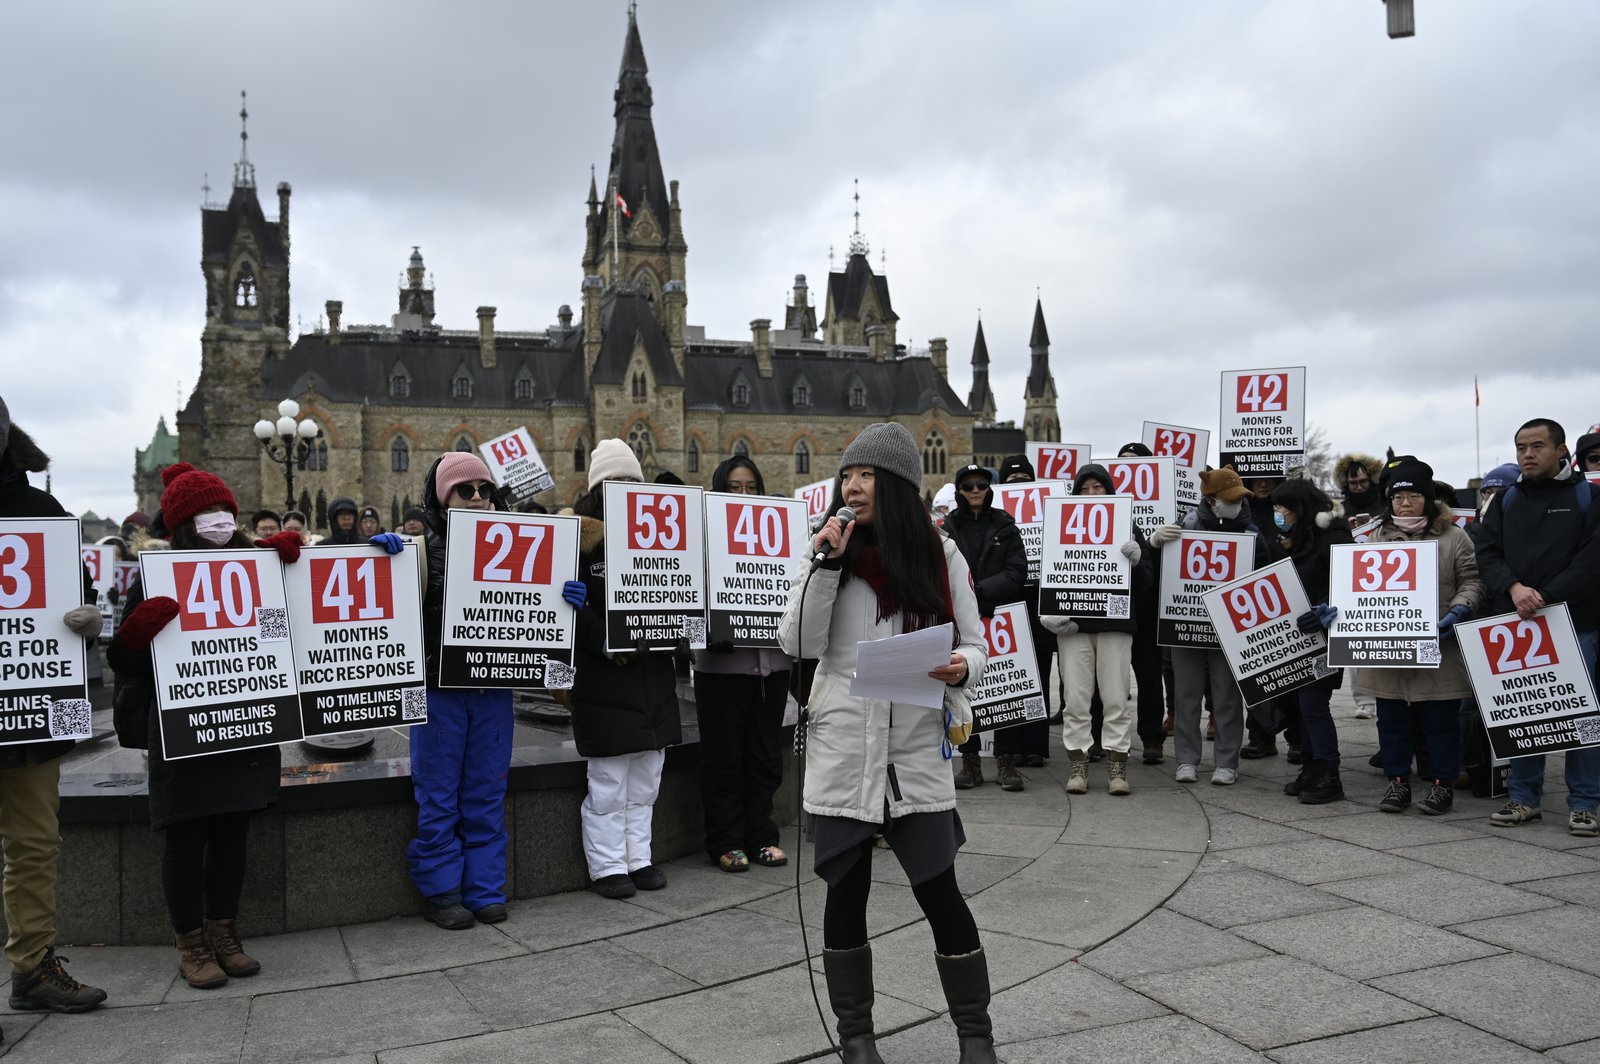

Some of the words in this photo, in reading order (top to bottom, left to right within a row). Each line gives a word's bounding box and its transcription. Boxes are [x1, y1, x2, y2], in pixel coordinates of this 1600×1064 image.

[1242, 374, 1282, 411] 42
[1241, 415, 1282, 426] MONTHS
[1231, 427, 1271, 437] WAITING
[1273, 426, 1293, 436] FOR
[495, 436, 522, 465] 19
[1158, 430, 1191, 466] 32
[1225, 439, 1246, 448] IRCC
[1247, 437, 1298, 447] RESPONSE
[505, 458, 529, 472] MONTHS
[1042, 449, 1072, 479] 72
[1234, 455, 1246, 463] NO
[1246, 454, 1283, 462] TIMELINE
[1238, 464, 1249, 472] NO
[1250, 463, 1284, 471] RESULTS
[502, 467, 526, 481] WAITING
[525, 462, 537, 471] FOR
[514, 467, 543, 484] RESPONSE
[520, 479, 540, 491] TIMELINE
[1113, 463, 1154, 500] 20
[1178, 480, 1194, 490] FOR
[805, 487, 824, 514] 70
[1176, 489, 1198, 500] ONSE
[1008, 488, 1043, 524] 71
[634, 494, 680, 549] 53
[1065, 504, 1109, 544] 40
[1146, 516, 1165, 525] FOR
[733, 505, 783, 556] 40
[1020, 526, 1042, 536] ONTH
[482, 523, 545, 582] 27
[1064, 550, 1107, 560] MONTHS
[1187, 540, 1230, 581] 65
[0, 534, 31, 609] 3
[82, 550, 97, 580] 6
[633, 557, 680, 570] MONTHS
[736, 562, 785, 576] MONTHS
[1053, 562, 1095, 572] WAITING
[1097, 562, 1118, 572] FOR
[1359, 549, 1410, 591] 32
[621, 573, 668, 587] WAITING
[671, 574, 692, 587] FOR
[723, 577, 773, 591] WAITING
[777, 579, 791, 591] FO
[1046, 574, 1069, 584] IRCC
[1070, 574, 1124, 585] RESPONSE
[1184, 583, 1216, 593] MONT
[187, 561, 253, 628] 40
[322, 558, 384, 620] 41
[480, 590, 542, 606] MONTHS
[614, 591, 639, 604] IRCC
[641, 590, 698, 603] RESPONSE
[1055, 591, 1068, 600] NO
[717, 592, 743, 605] IRCC
[745, 593, 788, 606] RESPON
[1059, 602, 1071, 611] NO
[1072, 602, 1108, 611] RESULTS
[1172, 594, 1202, 605] WAITI
[1230, 578, 1282, 629] 90
[1357, 596, 1409, 607] MONTHS
[463, 607, 524, 623] WAITING
[528, 610, 557, 624] FOR
[1165, 605, 1189, 616] IRCC
[1344, 609, 1395, 620] WAITING
[1398, 609, 1423, 619] FOR
[0, 617, 35, 635] THS
[626, 615, 639, 626] NO
[729, 615, 744, 626] NO
[745, 616, 781, 627] TIMELI
[1175, 623, 1188, 632] NO
[1188, 624, 1214, 633] TIMEL
[1337, 622, 1363, 632] IRCC
[1365, 621, 1430, 632] RESPONSE
[324, 626, 388, 644] MONTHS
[452, 625, 486, 640] IRCC
[487, 626, 565, 642] RESPONSE
[630, 629, 643, 640] NO
[645, 628, 684, 640] RESULTS
[734, 628, 748, 639] NO
[750, 628, 779, 639] RESU
[1178, 633, 1191, 641] NO
[1191, 634, 1219, 643] RESUL
[1245, 619, 1292, 645] MONTHS
[19, 639, 59, 657] FOR
[191, 636, 258, 656] MONTHS
[308, 646, 372, 664] WAITING
[377, 643, 406, 659] FOR
[1240, 636, 1285, 660] WAITING
[1348, 640, 1363, 649] NO
[1364, 640, 1416, 649] TIMELINES
[1489, 620, 1551, 673] 22
[466, 651, 484, 664] NO
[485, 652, 548, 665] TIMELINES
[1238, 660, 1263, 675] IRCC
[1263, 635, 1319, 665] RESPONSE
[1352, 651, 1367, 660] NO
[1369, 650, 1413, 660] RESULTS
[0, 660, 72, 681] PONSE
[176, 657, 243, 678] WAITING
[247, 655, 277, 672] FOR
[300, 668, 334, 685] IRCC
[336, 660, 415, 681] RESPONSE
[470, 666, 488, 678] NO
[490, 667, 542, 680] RESULTS
[984, 659, 1015, 674] ONTHS
[1256, 675, 1270, 686] NO
[1270, 656, 1313, 680] TIMELINES
[168, 682, 206, 701] IRCC
[207, 673, 288, 697] RESPONSE
[971, 673, 1006, 689] AITING
[1008, 668, 1027, 681] FOR
[1263, 683, 1277, 694] NO
[1277, 668, 1314, 688] RESULTS
[1501, 671, 1557, 691] MONTHS
[985, 679, 1035, 699] RESPONSE
[1493, 688, 1547, 707] WAITING
[1549, 682, 1576, 698] FOR
[0, 694, 52, 712] LINES
[317, 695, 334, 709] NO
[336, 689, 401, 707] TIMELINES
[974, 706, 986, 717] NO
[987, 699, 1024, 715] TIMELINE
[189, 712, 207, 727] NO
[209, 704, 276, 724] TIMELINES
[323, 711, 340, 725] NO
[344, 705, 397, 722] RESULTS
[1490, 707, 1518, 722] IRCC
[1520, 695, 1589, 717] RESPONSE
[0, 714, 45, 730] ULTS
[980, 716, 991, 726] NO
[993, 710, 1026, 724] RESULTS
[196, 728, 215, 744] NO
[218, 721, 273, 741] RESULTS
[1508, 727, 1523, 738] NO
[1524, 719, 1575, 735] TIMELINE
[1516, 738, 1532, 749] NO
[1533, 731, 1579, 747] RESULTS
